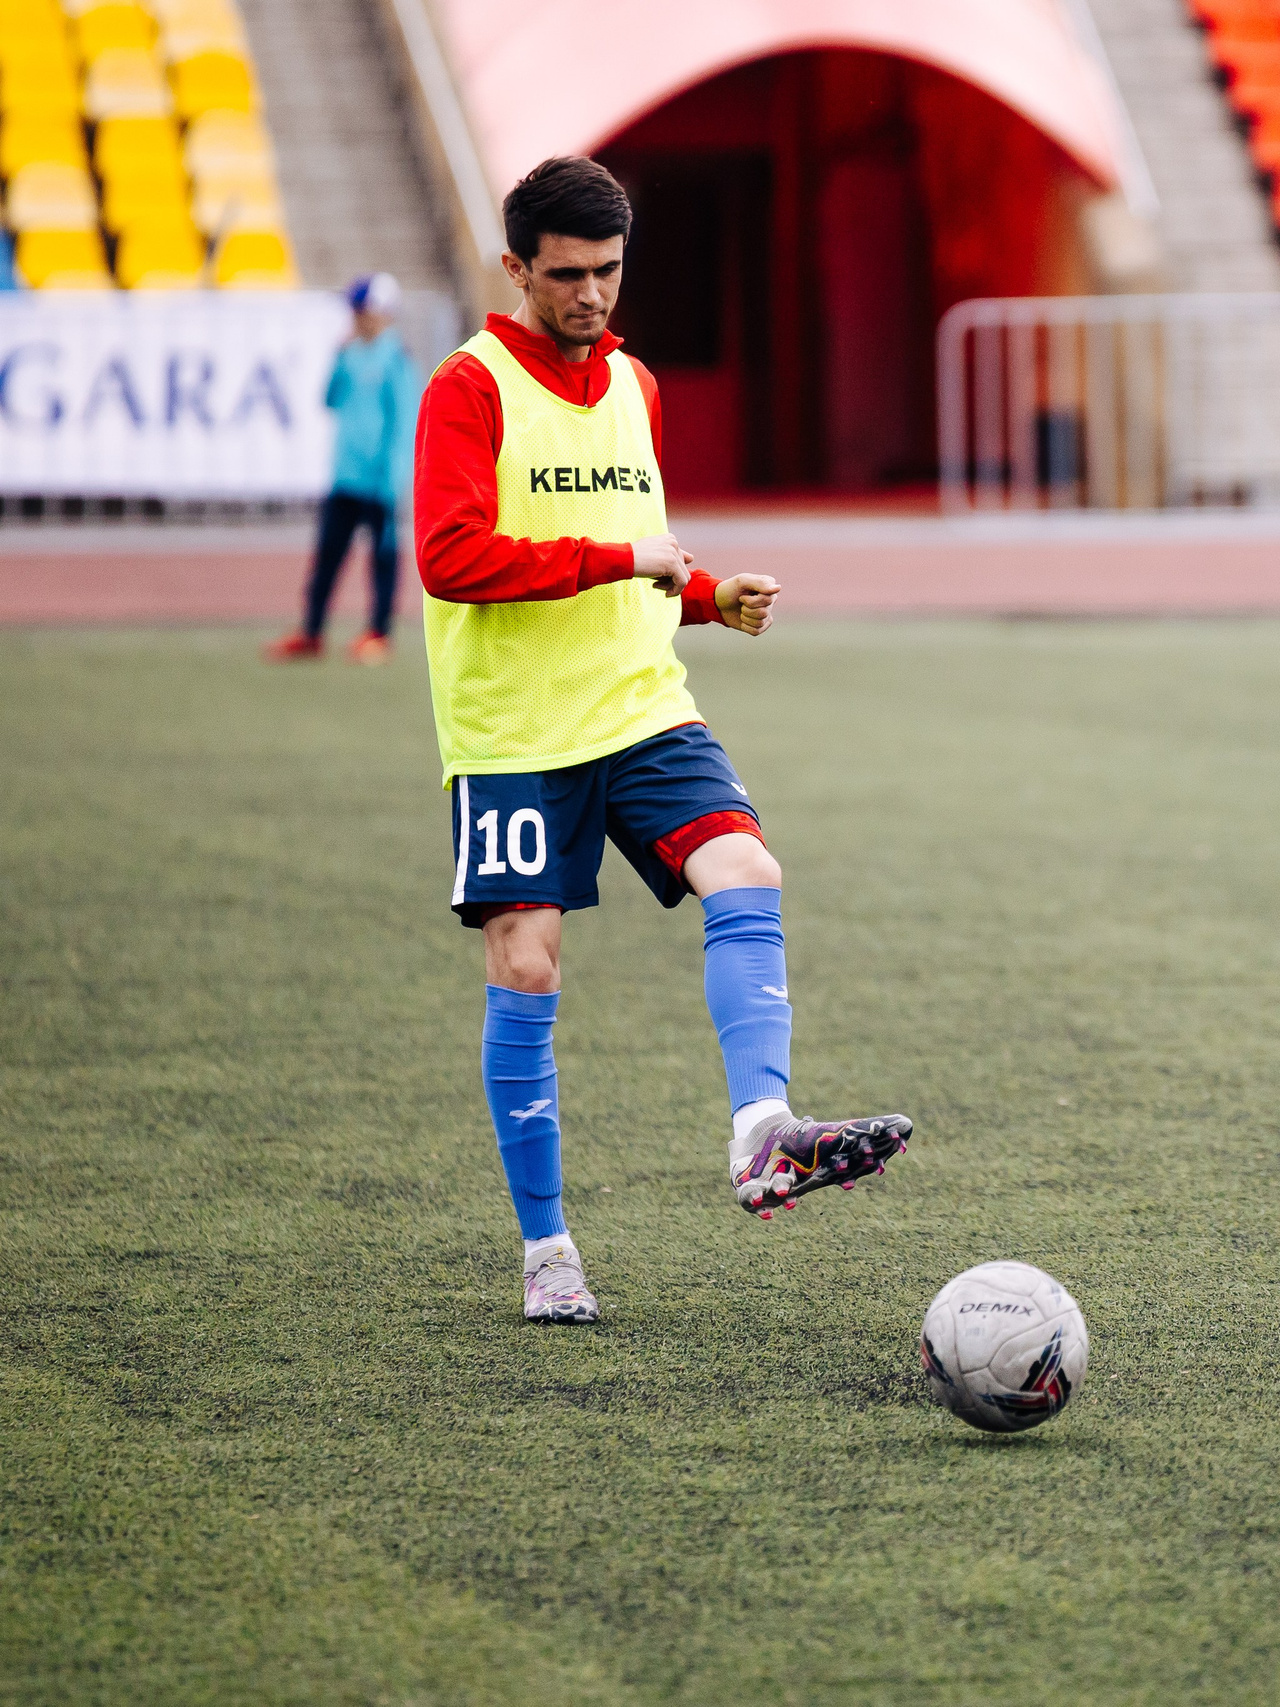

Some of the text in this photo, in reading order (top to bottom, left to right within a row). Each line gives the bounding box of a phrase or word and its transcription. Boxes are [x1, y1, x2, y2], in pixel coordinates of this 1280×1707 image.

[0, 341, 294, 431] GARA
[530, 466, 634, 493] KELME
[476, 807, 547, 876] 10
[959, 1302, 1035, 1317] DEMIX
